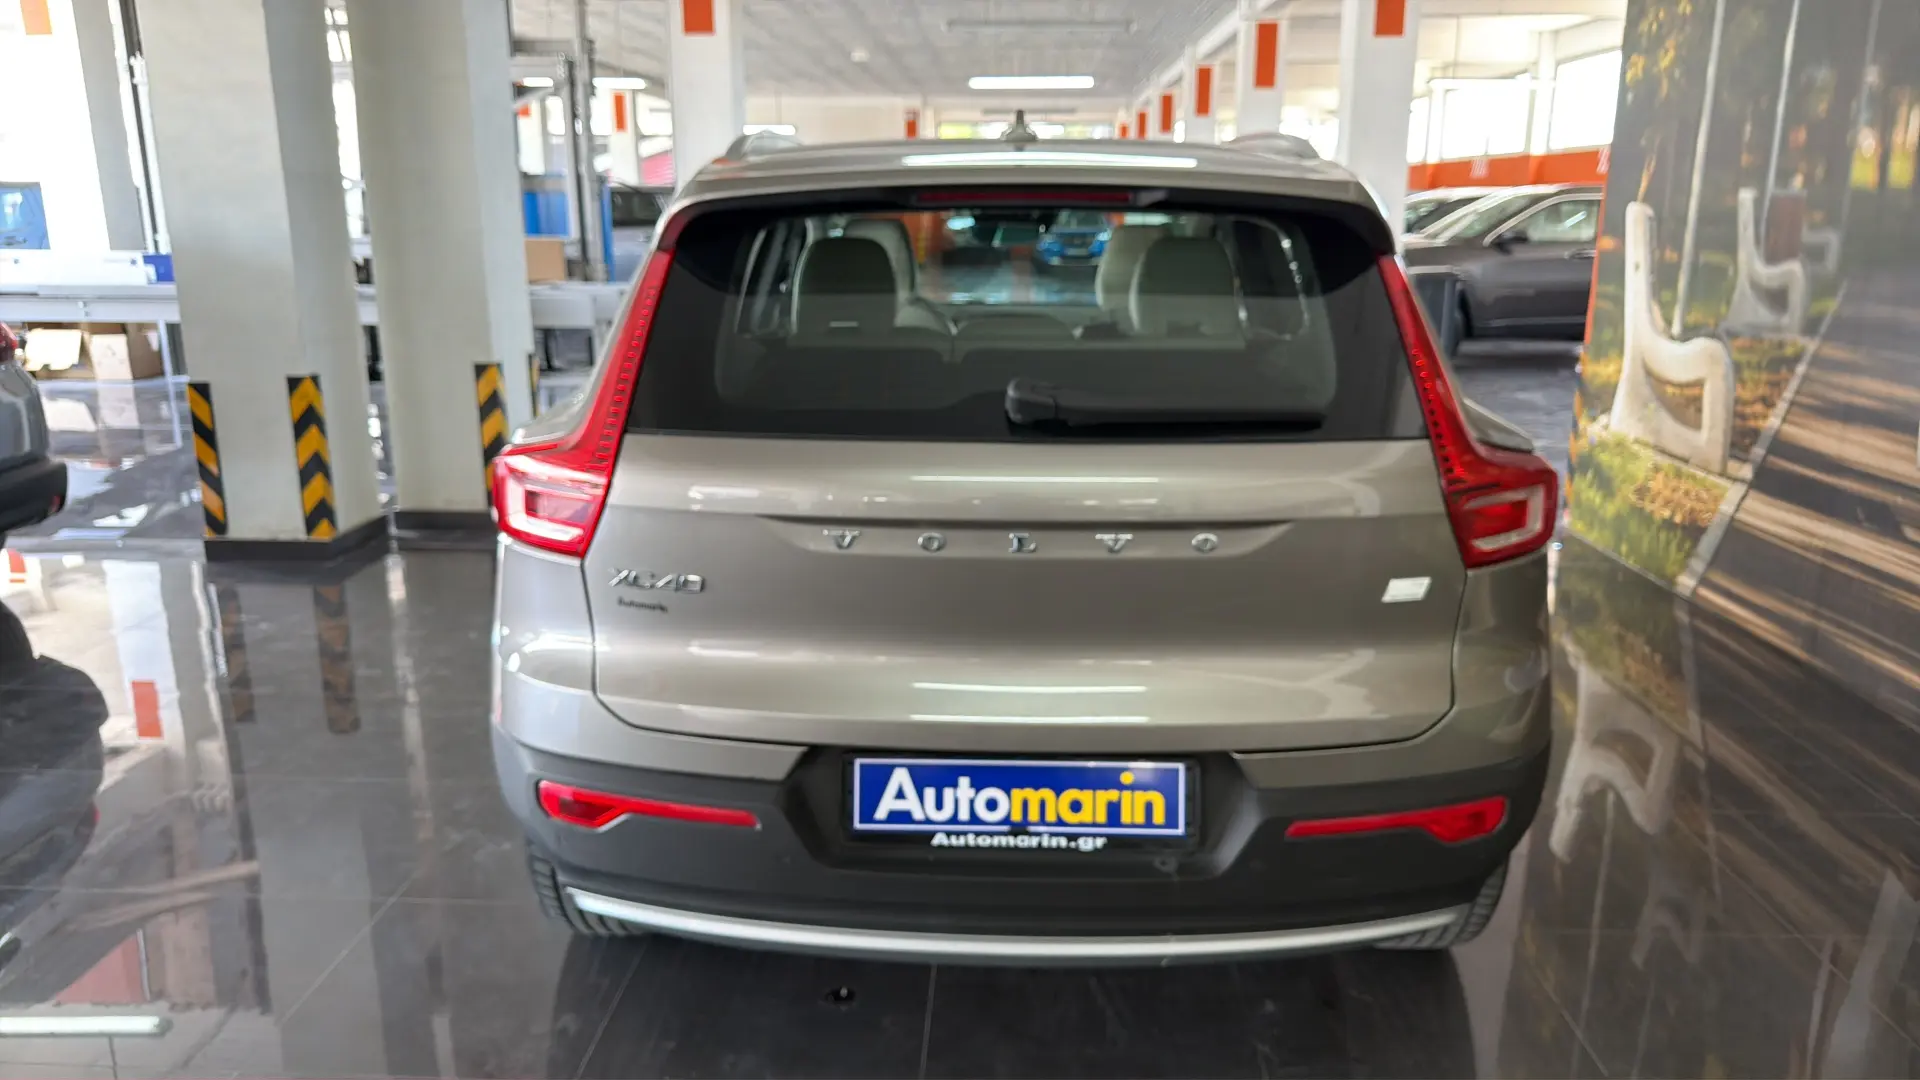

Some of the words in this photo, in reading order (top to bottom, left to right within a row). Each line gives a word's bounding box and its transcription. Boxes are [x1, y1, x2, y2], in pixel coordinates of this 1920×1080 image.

[822, 529, 1219, 554] VOLVO
[608, 567, 705, 594] XC40
[873, 767, 1166, 825] Automarin
[930, 831, 1107, 852] Automarin.gr
